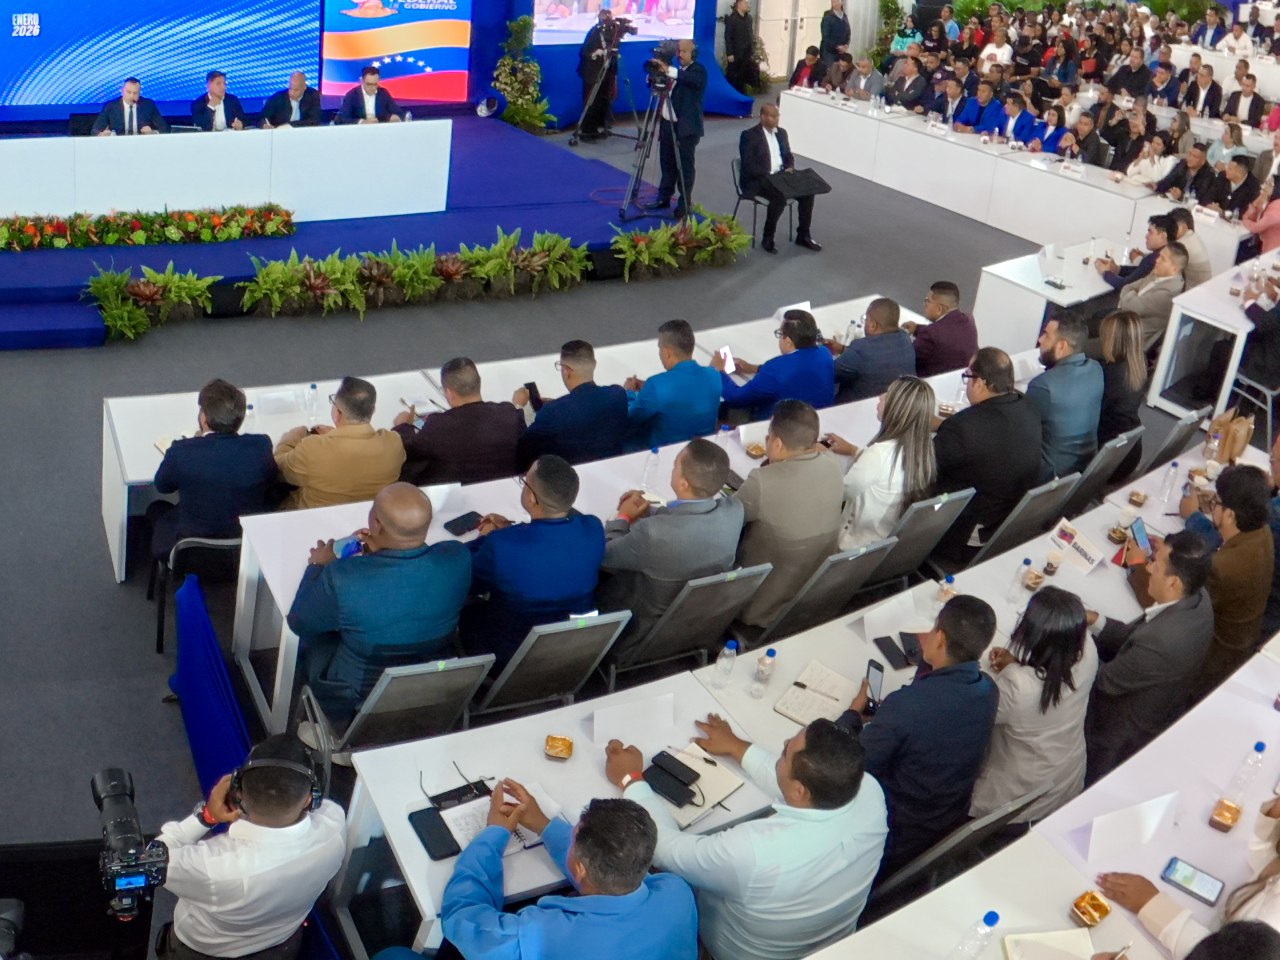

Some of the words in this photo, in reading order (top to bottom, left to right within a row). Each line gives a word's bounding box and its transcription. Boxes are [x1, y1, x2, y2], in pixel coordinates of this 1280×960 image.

[403, 2, 458, 10] GOBIERNO
[12, 13, 40, 26] ENERO
[12, 25, 41, 37] 2026
